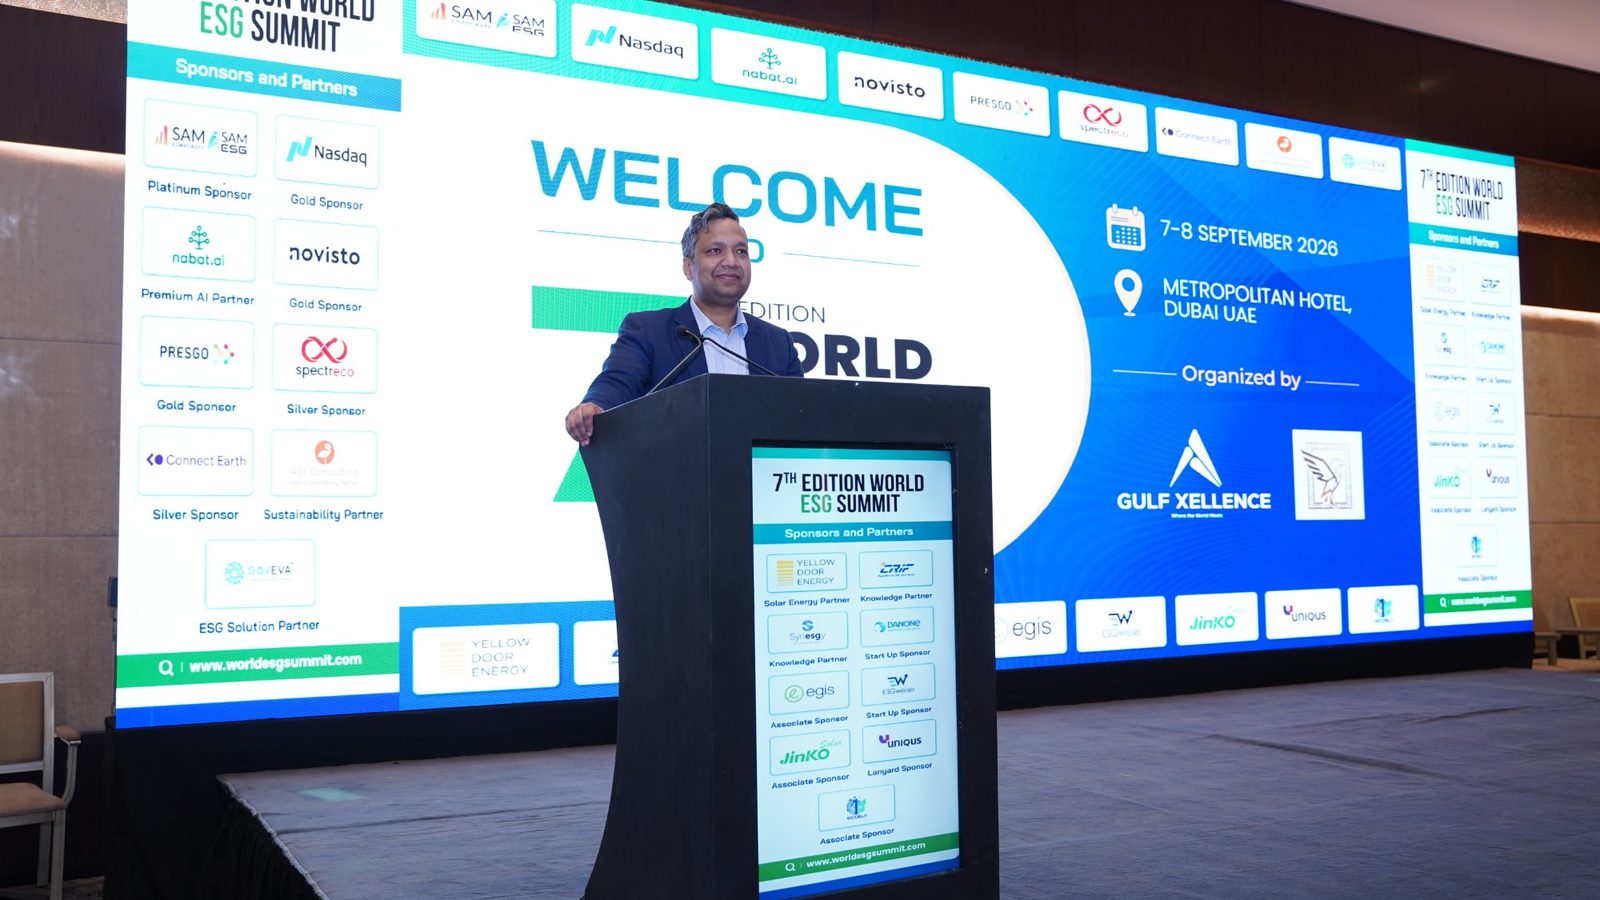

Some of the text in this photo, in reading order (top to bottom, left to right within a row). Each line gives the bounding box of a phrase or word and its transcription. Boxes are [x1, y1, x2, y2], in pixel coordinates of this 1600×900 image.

[451, 5, 493, 24] SAM
[513, 14, 545, 28] SAM
[200, 1, 341, 52] ESG SUMMIT
[619, 34, 684, 59] Nasdaq
[175, 58, 358, 97] Sponsors and Partners
[742, 68, 797, 86] nabat.ai
[854, 75, 925, 98] novisto
[970, 95, 1012, 111] PRESGO
[172, 127, 205, 143] SAM
[221, 131, 248, 144] SAM
[1175, 129, 1233, 147] Connect Earth
[220, 144, 247, 155] ESG
[314, 145, 367, 167] Nasdaq
[148, 180, 252, 200] Platinum Sponsor
[531, 140, 923, 237] WELCOME
[1436, 171, 1470, 196] EDITION
[1472, 177, 1503, 200] WORLD
[291, 194, 364, 210] Gold Sponsor
[1436, 194, 1490, 221] ESG SUMMIT
[1159, 219, 1338, 257] 7-8 SEPTEMBER 2026
[172, 253, 225, 267] nabat.ai
[289, 246, 361, 265] novisto
[141, 288, 255, 305] Premium AI Partner
[1163, 277, 1352, 315] METROPOLITAN HOTEL,
[289, 298, 362, 313] Gold Sponsor
[1164, 299, 1257, 324] DUBAI UAE
[160, 345, 209, 360] PRESGO
[787, 331, 932, 380] ORLD
[295, 364, 355, 379] spectreco
[1182, 365, 1301, 391] Organized by
[157, 400, 237, 414] Gold Sponsor
[287, 403, 366, 417] Silver Sponsor
[166, 455, 246, 467] Connect Earth
[802, 473, 865, 492] EDITION
[869, 473, 925, 492] WORLD
[801, 494, 900, 513] ESG SUMMIT
[1116, 492, 1272, 510] GULF XELLENCE
[152, 509, 239, 522] Silver Sponsor
[263, 509, 384, 522] Sustainability Partner
[784, 527, 913, 540] Sponsors and Partners
[797, 558, 835, 567] YELLOW
[797, 568, 825, 576] DOOR
[797, 577, 835, 586] ENERGY
[764, 599, 786, 607] Solar
[788, 598, 818, 607] Energy
[860, 592, 933, 603] Knowledge Partner
[199, 620, 320, 633] ESG Solution Partner
[1012, 616, 1052, 640] egis
[1189, 615, 1236, 631] JinKO
[471, 638, 530, 649] YELLOW
[789, 632, 826, 642] Synesgy
[472, 652, 514, 663] DOOR
[769, 656, 848, 667] Knowledge Partner
[865, 649, 931, 660] Start Up Sponsor
[189, 654, 362, 673] www.worldesgsummit.com
[472, 665, 528, 677] ENERGY
[806, 685, 835, 700] egis
[866, 706, 932, 719] Start Up Sponsor
[770, 716, 849, 729] Associate Sponsor
[779, 748, 830, 765] JinKO
[867, 762, 933, 777] Lanyard Sponsor
[771, 774, 850, 789] Associate Sponsor
[820, 828, 895, 845] Associate Sponsor
[806, 842, 926, 868] www.worldesgsummit.com
